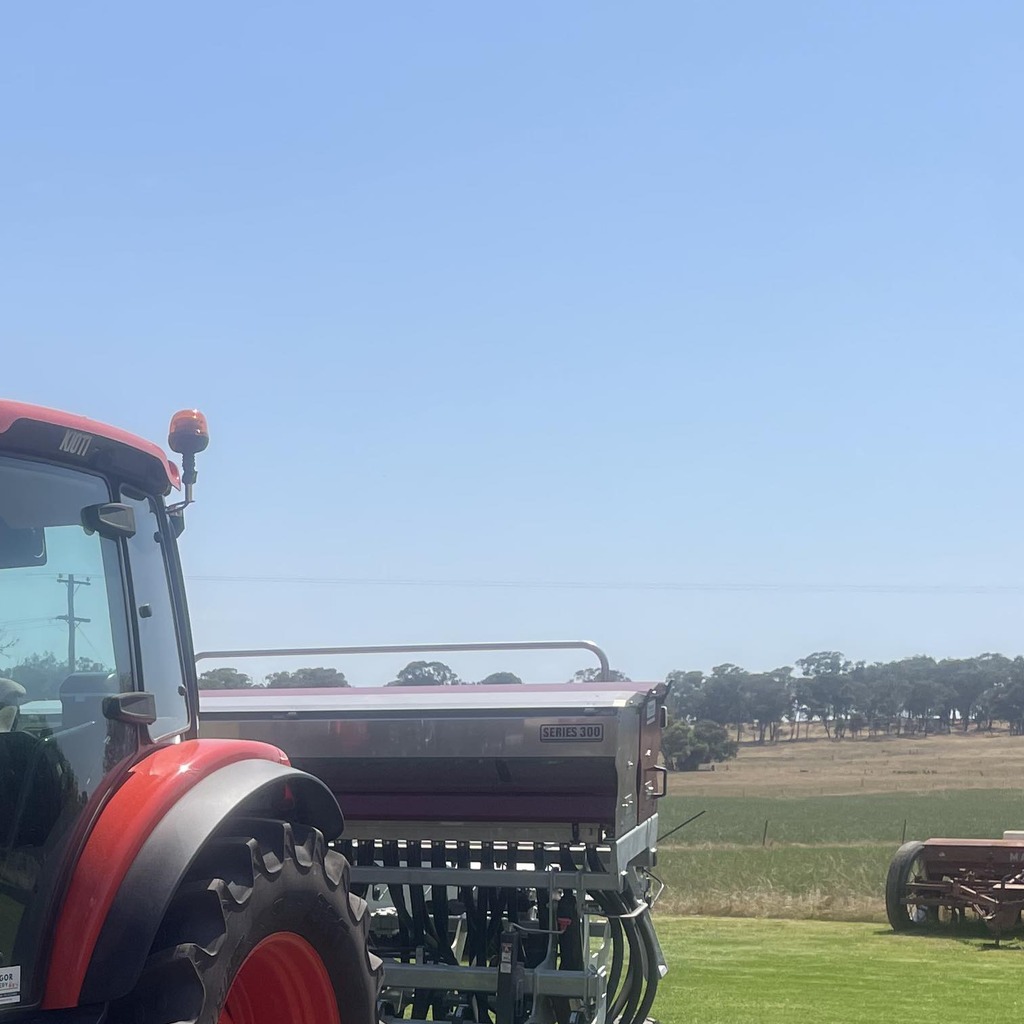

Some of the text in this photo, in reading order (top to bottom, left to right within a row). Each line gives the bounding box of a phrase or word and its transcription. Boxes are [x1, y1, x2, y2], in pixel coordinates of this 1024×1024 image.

[59, 429, 93, 456] KIOTI
[542, 726, 601, 738] SERIES 300
